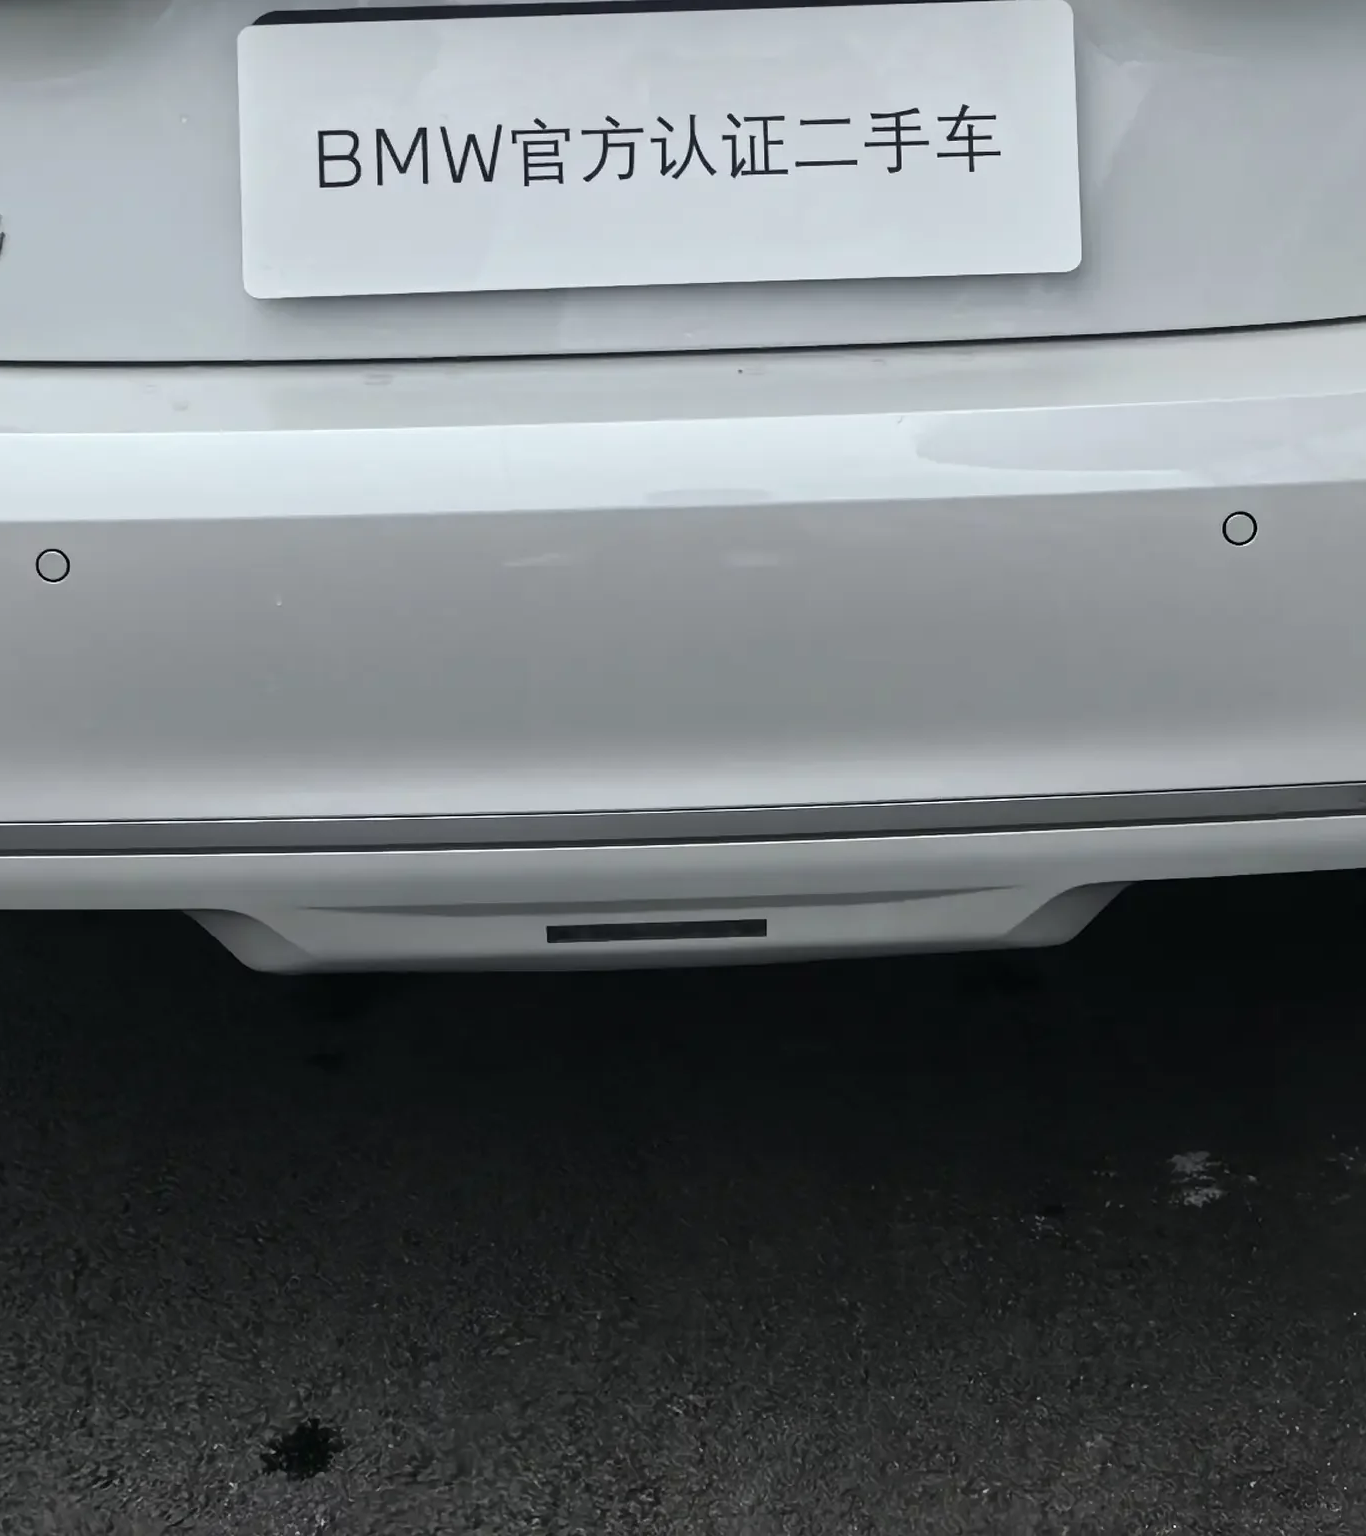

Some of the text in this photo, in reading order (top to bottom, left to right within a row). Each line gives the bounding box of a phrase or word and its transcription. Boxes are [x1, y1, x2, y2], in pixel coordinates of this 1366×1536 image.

[315, 102, 1004, 189] BMW官方认证二手车
